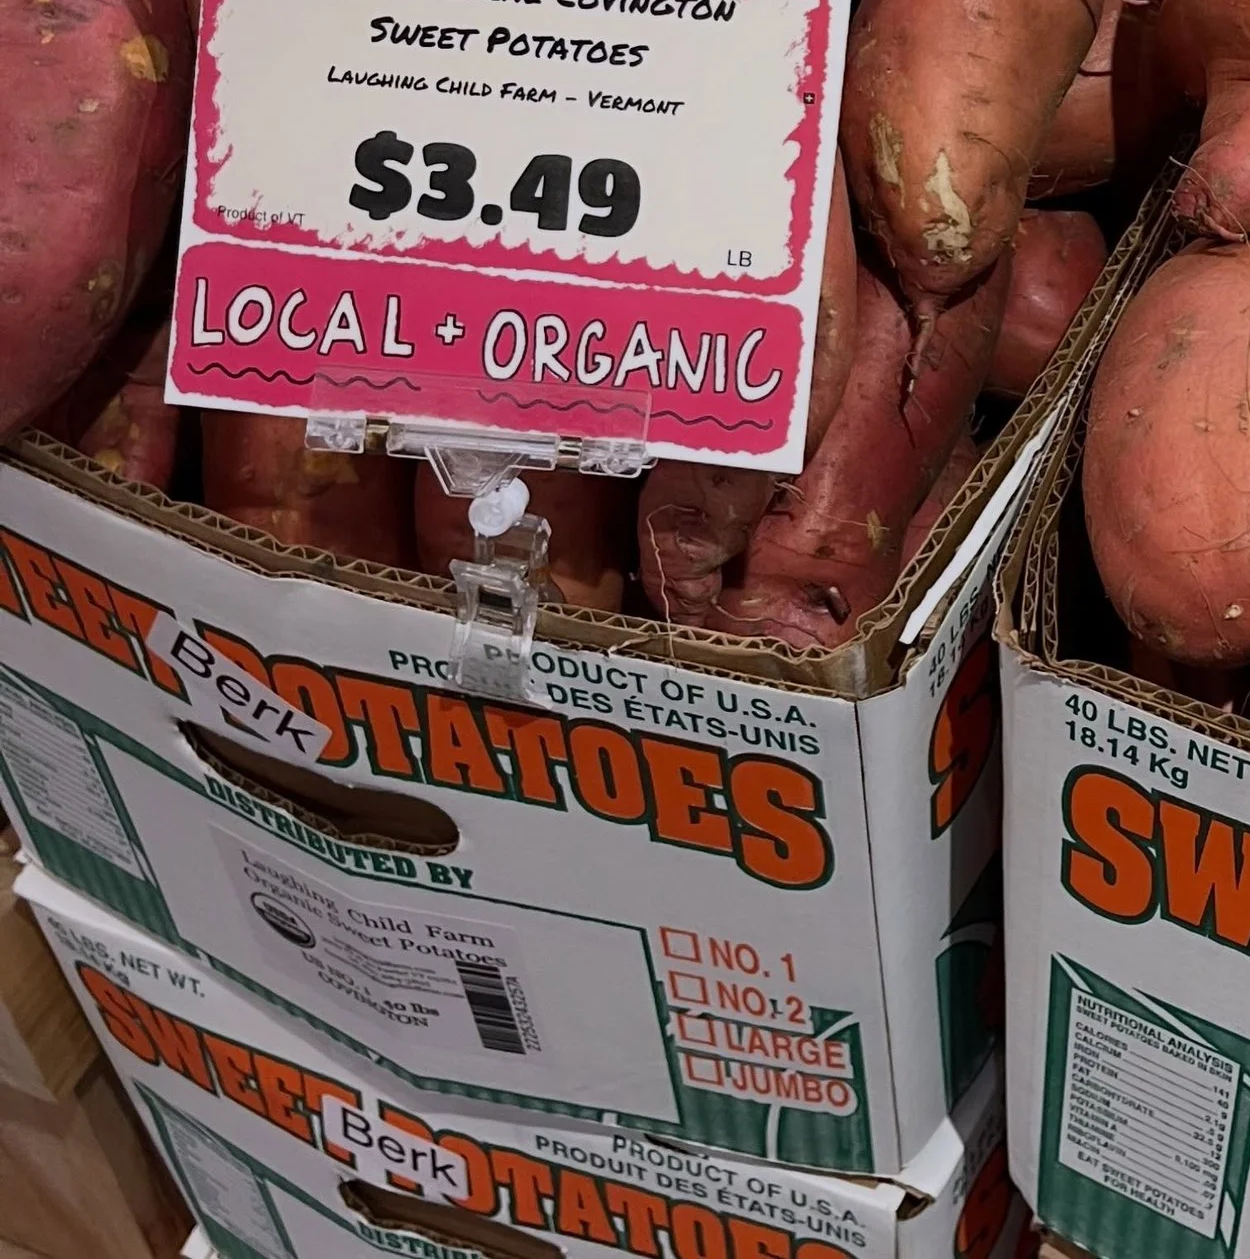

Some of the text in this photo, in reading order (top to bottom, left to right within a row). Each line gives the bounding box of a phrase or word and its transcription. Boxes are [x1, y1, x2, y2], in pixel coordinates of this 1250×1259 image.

[369, 15, 650, 68] SWEET POTATOES
[327, 66, 429, 92] LAUGHING
[435, 77, 493, 97] CHILD
[500, 83, 557, 104] FARM
[588, 91, 685, 116] VERMONT
[217, 205, 305, 226] Product of VT
[348, 130, 642, 238] $3.49
[726, 248, 753, 269] LB
[190, 276, 416, 359] LOCAL
[478, 308, 784, 403] ORGANIC
[168, 630, 316, 753] Berk
[548, 682, 821, 756] DES ÉTATS-UNIS
[661, 674, 707, 704] OF
[717, 689, 817, 728] U.S.A.
[1065, 693, 1098, 723] 40
[1107, 708, 1176, 755] LBS.
[1188, 738, 1250, 783] NET
[1065, 719, 1190, 790] 18.14 Kg
[204, 773, 474, 889] DISTRIBUTED BY
[240, 849, 339, 914] Laughing
[347, 908, 412, 934] Child
[425, 923, 496, 948] Farm
[328, 912, 392, 949] Sweet
[400, 938, 508, 969] Potatoes
[708, 936, 796, 983] NO. 1
[121, 951, 162, 980] NET
[167, 968, 208, 999] WT.
[785, 994, 806, 1025] 2
[724, 1021, 847, 1070] LARGE
[731, 1062, 851, 1111] JUMBO
[341, 1107, 459, 1188] Berk
[611, 1120, 867, 1228] PRODUCT OF U.S.A.
[535, 1134, 868, 1248] PRODUIT DES ÉTATS-UNIS
